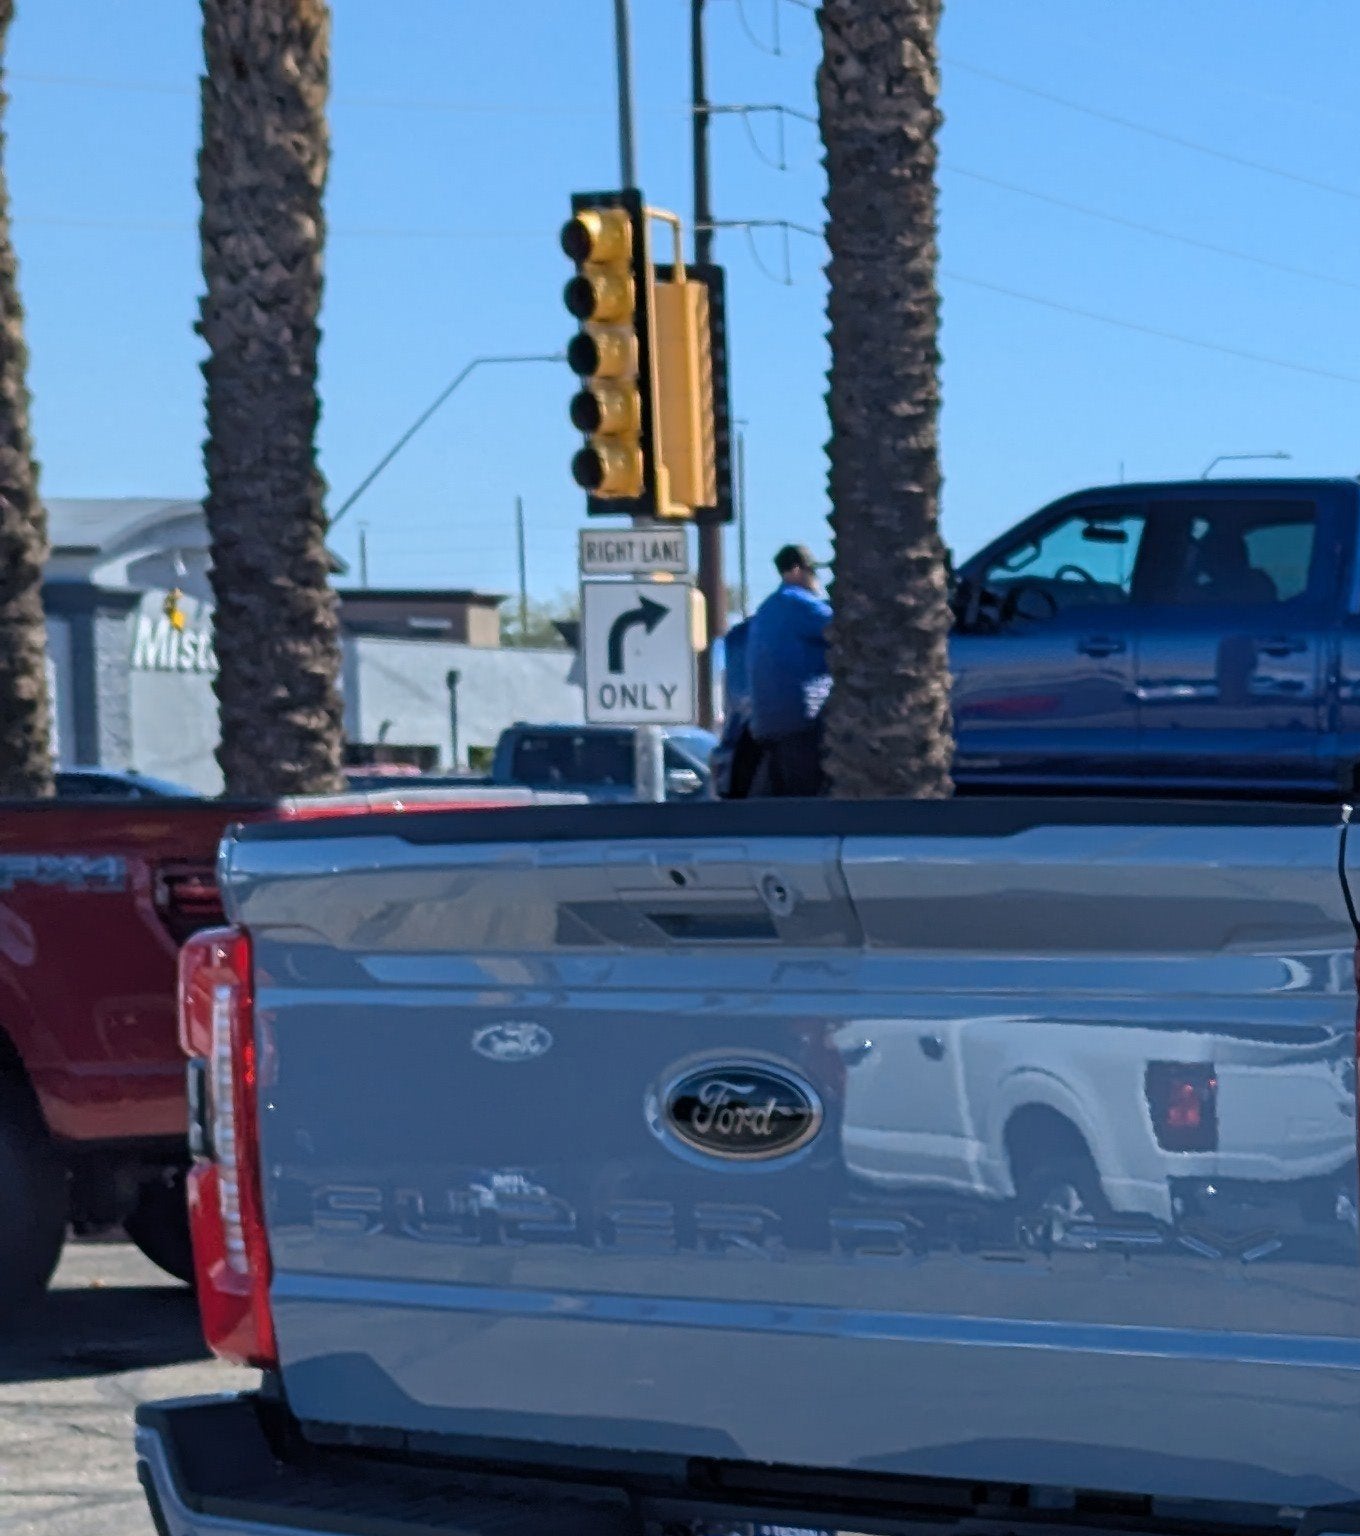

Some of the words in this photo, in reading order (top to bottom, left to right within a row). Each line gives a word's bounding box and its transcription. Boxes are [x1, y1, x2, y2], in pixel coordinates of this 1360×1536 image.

[586, 540, 635, 563] RIGHT
[641, 540, 681, 563] LANE
[133, 614, 219, 669] Mist
[599, 683, 678, 710] ONLY
[691, 1079, 778, 1137] Ford
